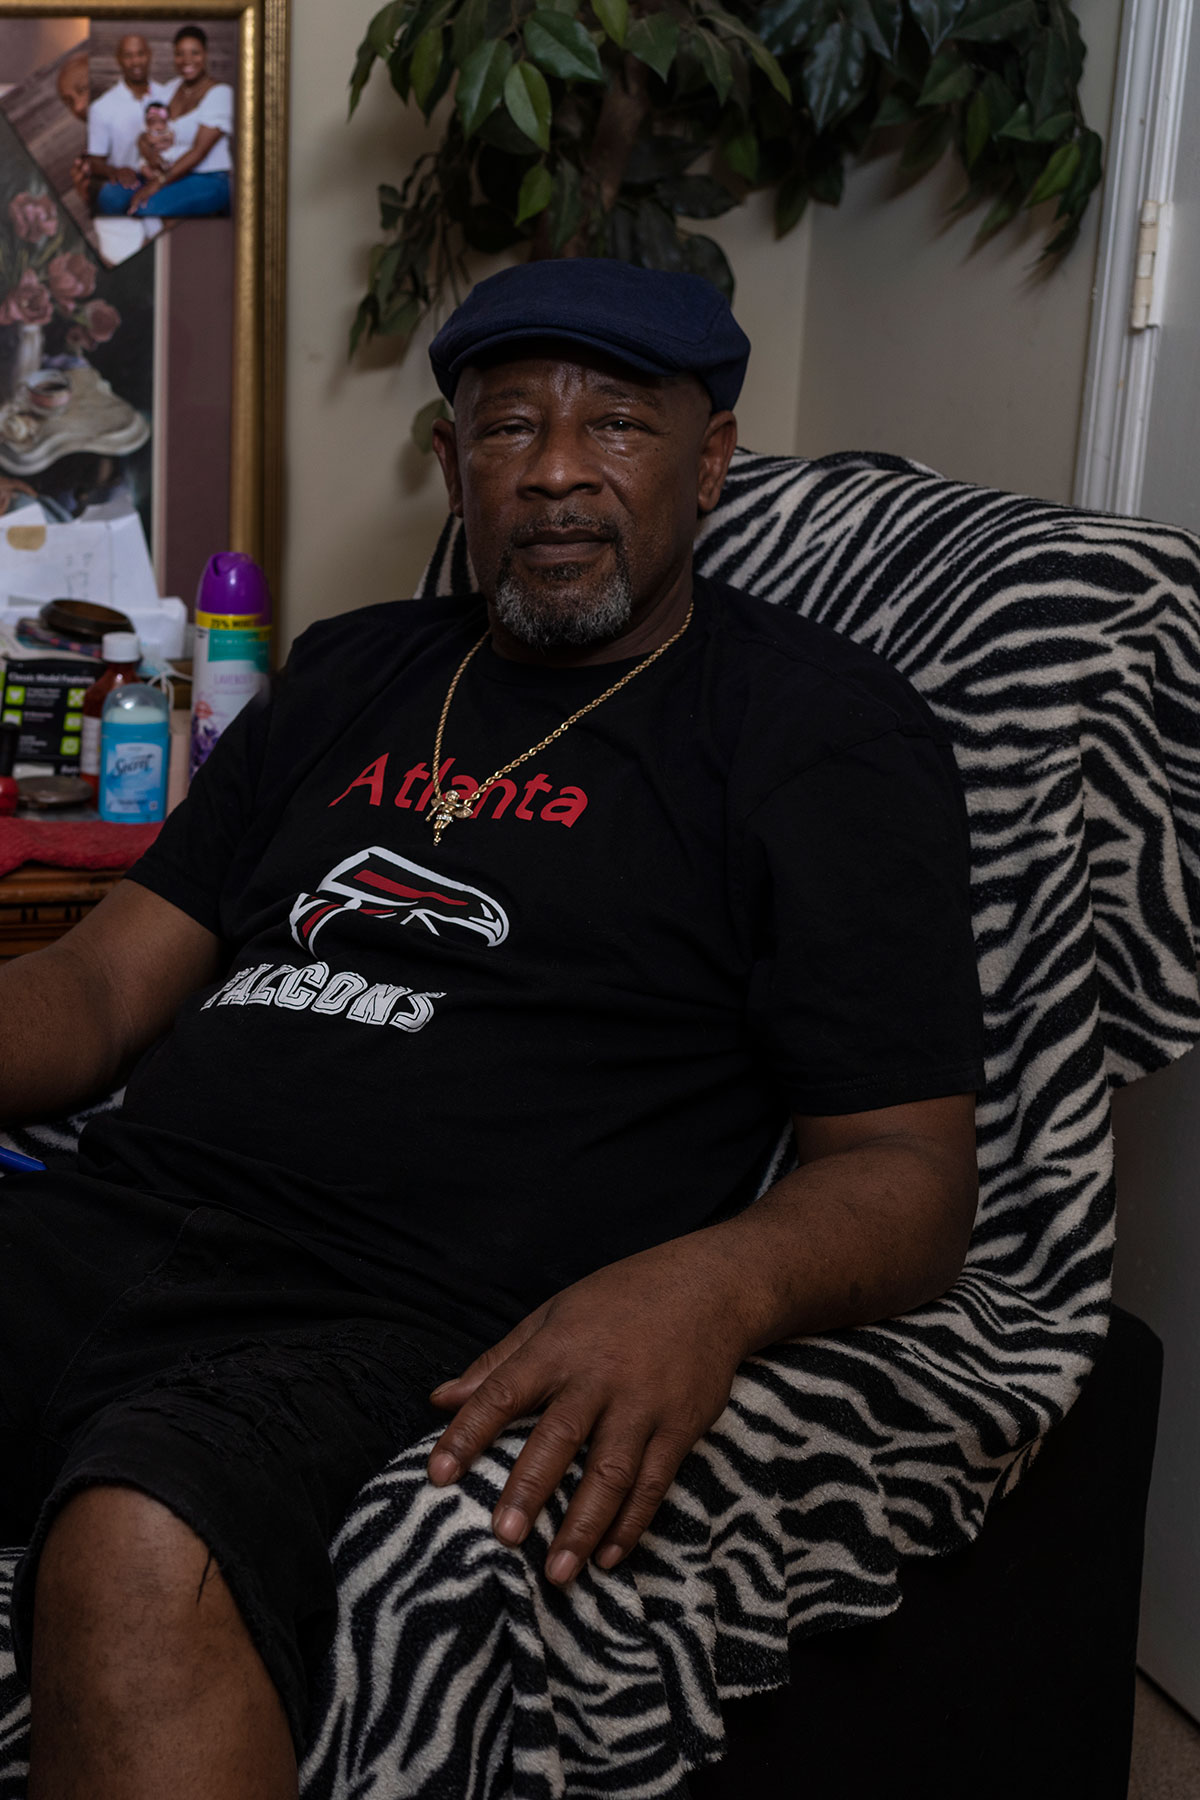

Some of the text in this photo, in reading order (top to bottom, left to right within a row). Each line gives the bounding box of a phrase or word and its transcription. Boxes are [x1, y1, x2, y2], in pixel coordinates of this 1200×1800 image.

[113, 754, 154, 776] Secret
[328, 752, 589, 829] Atlanta
[200, 961, 447, 1034] FALCONS
